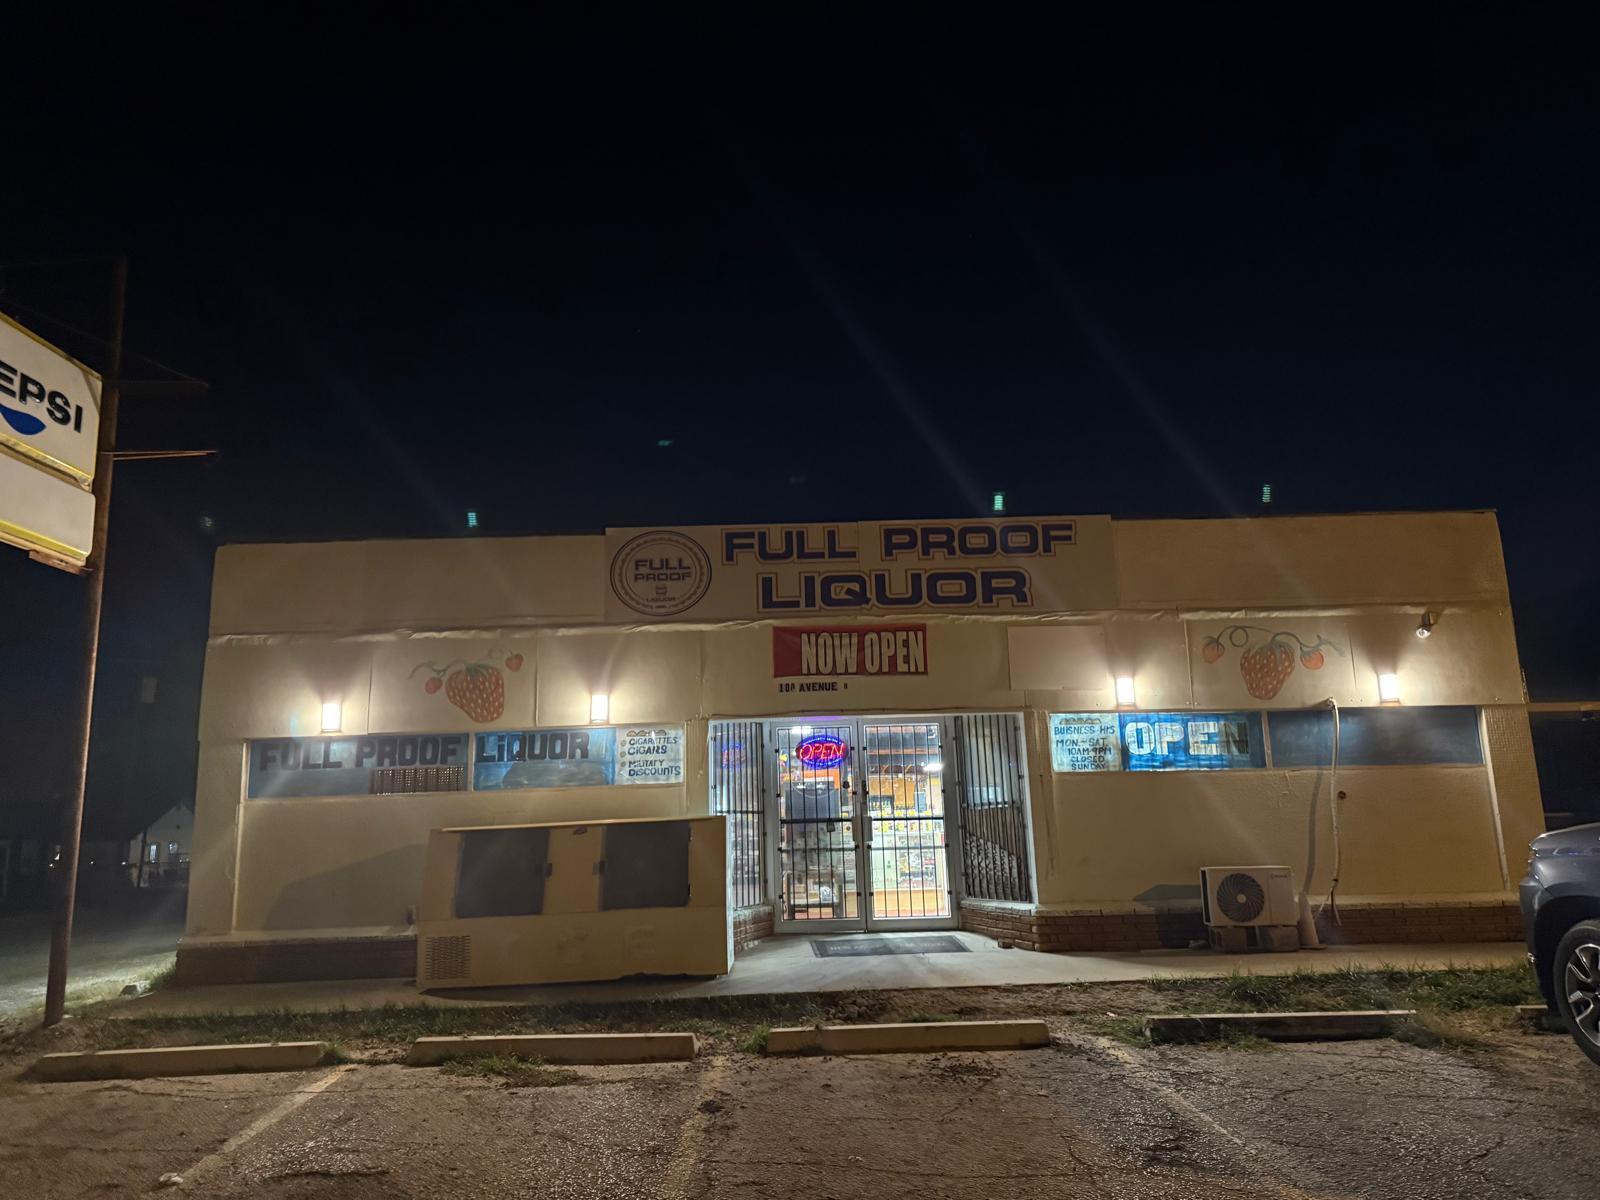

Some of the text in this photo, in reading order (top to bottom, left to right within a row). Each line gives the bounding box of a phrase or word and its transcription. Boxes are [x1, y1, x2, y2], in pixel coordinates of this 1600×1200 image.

[723, 528, 858, 562] FULL
[883, 523, 1075, 557] PROOF
[634, 572, 692, 582] PROOF
[635, 558, 691, 571] FULL
[759, 570, 1030, 609] LIQUOR
[800, 630, 926, 675] NOW OPEN
[799, 681, 838, 692] AVENUE
[259, 743, 342, 771] FULL
[355, 735, 462, 769] PROOF
[799, 742, 844, 760] OPEN
[1125, 721, 1250, 756] OPEN
